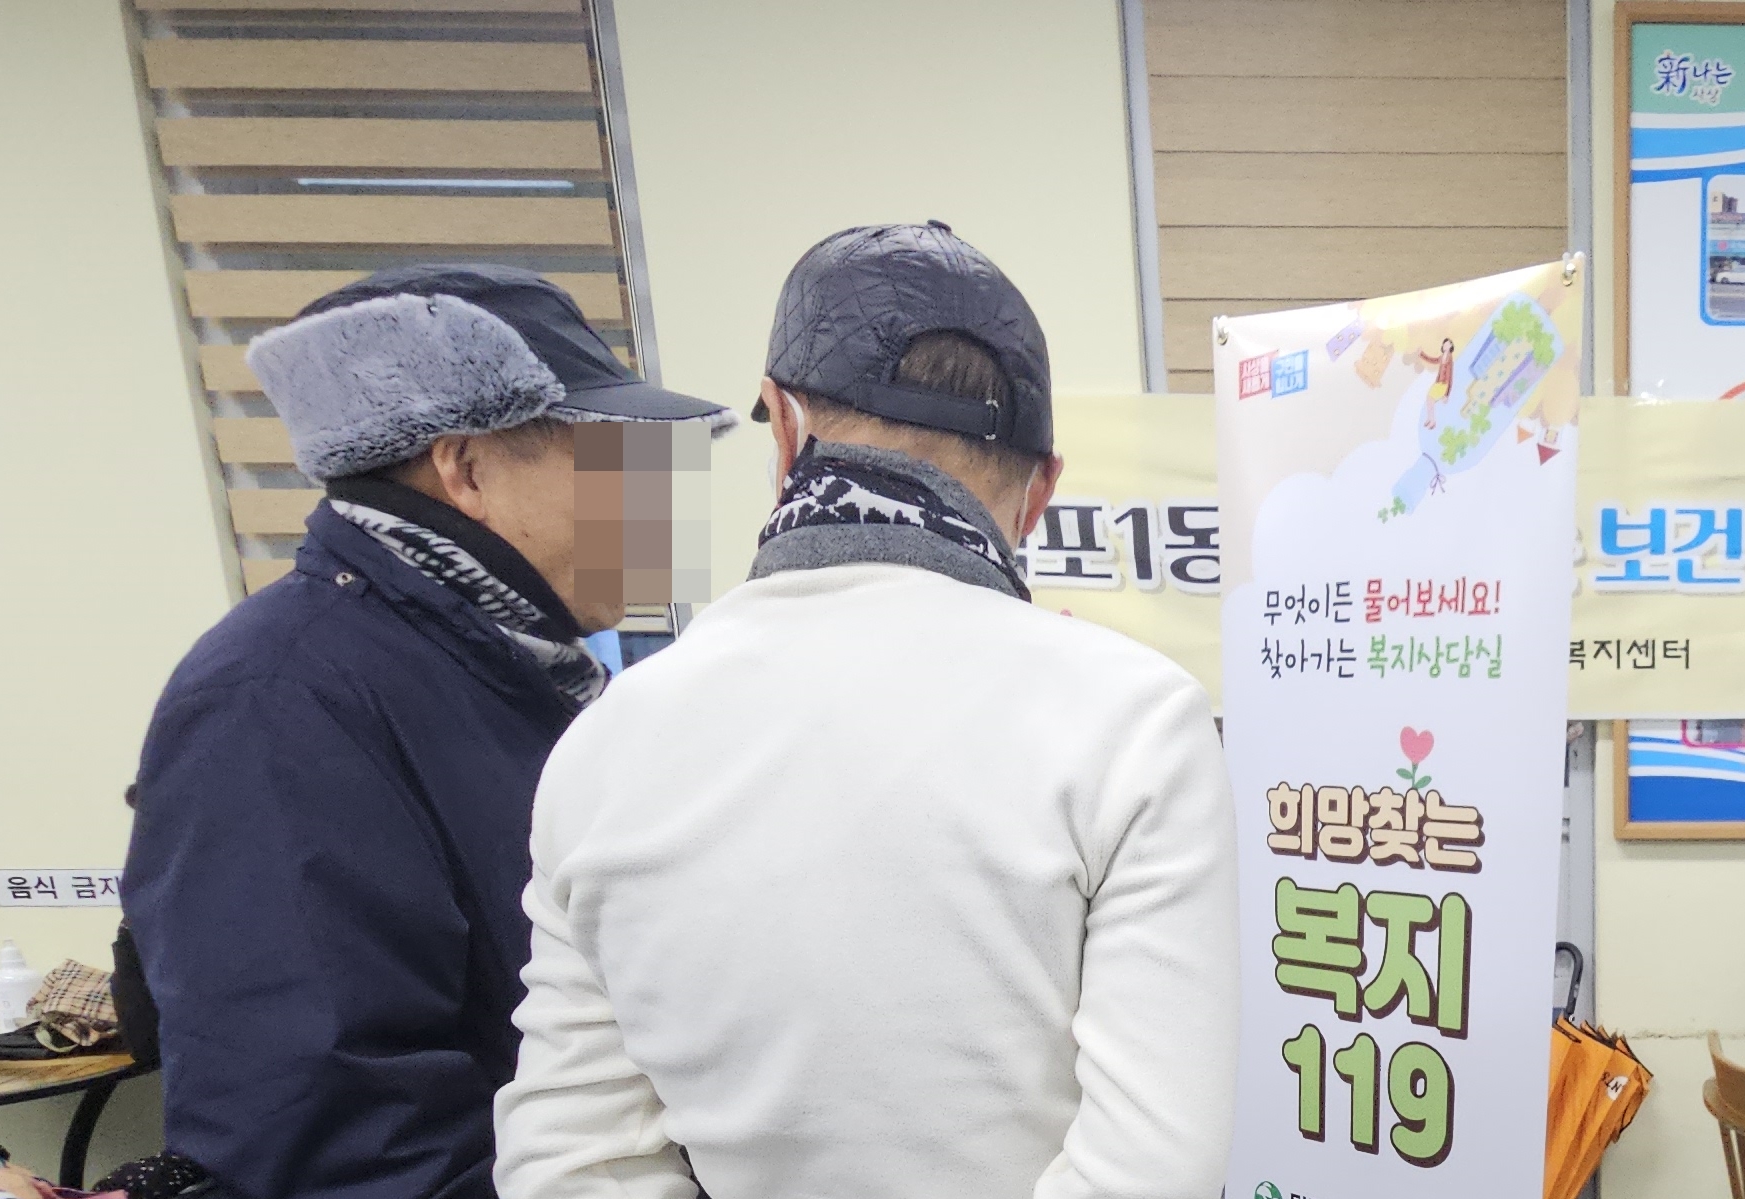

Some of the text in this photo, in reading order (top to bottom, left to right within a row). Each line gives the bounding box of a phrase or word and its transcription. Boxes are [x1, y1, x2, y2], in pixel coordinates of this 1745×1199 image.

[1016, 506, 1221, 584] 포1동
[1595, 508, 1743, 584] 보건
[1264, 577, 1502, 626] 무엇이든 물어보세요!
[1261, 634, 1503, 680] 찾아가는 복지상담실
[1266, 781, 1485, 874] 희망찾는
[7, 875, 121, 899] 음식 금지
[1272, 876, 1472, 1040] 복지
[1281, 1023, 1456, 1168] 119
